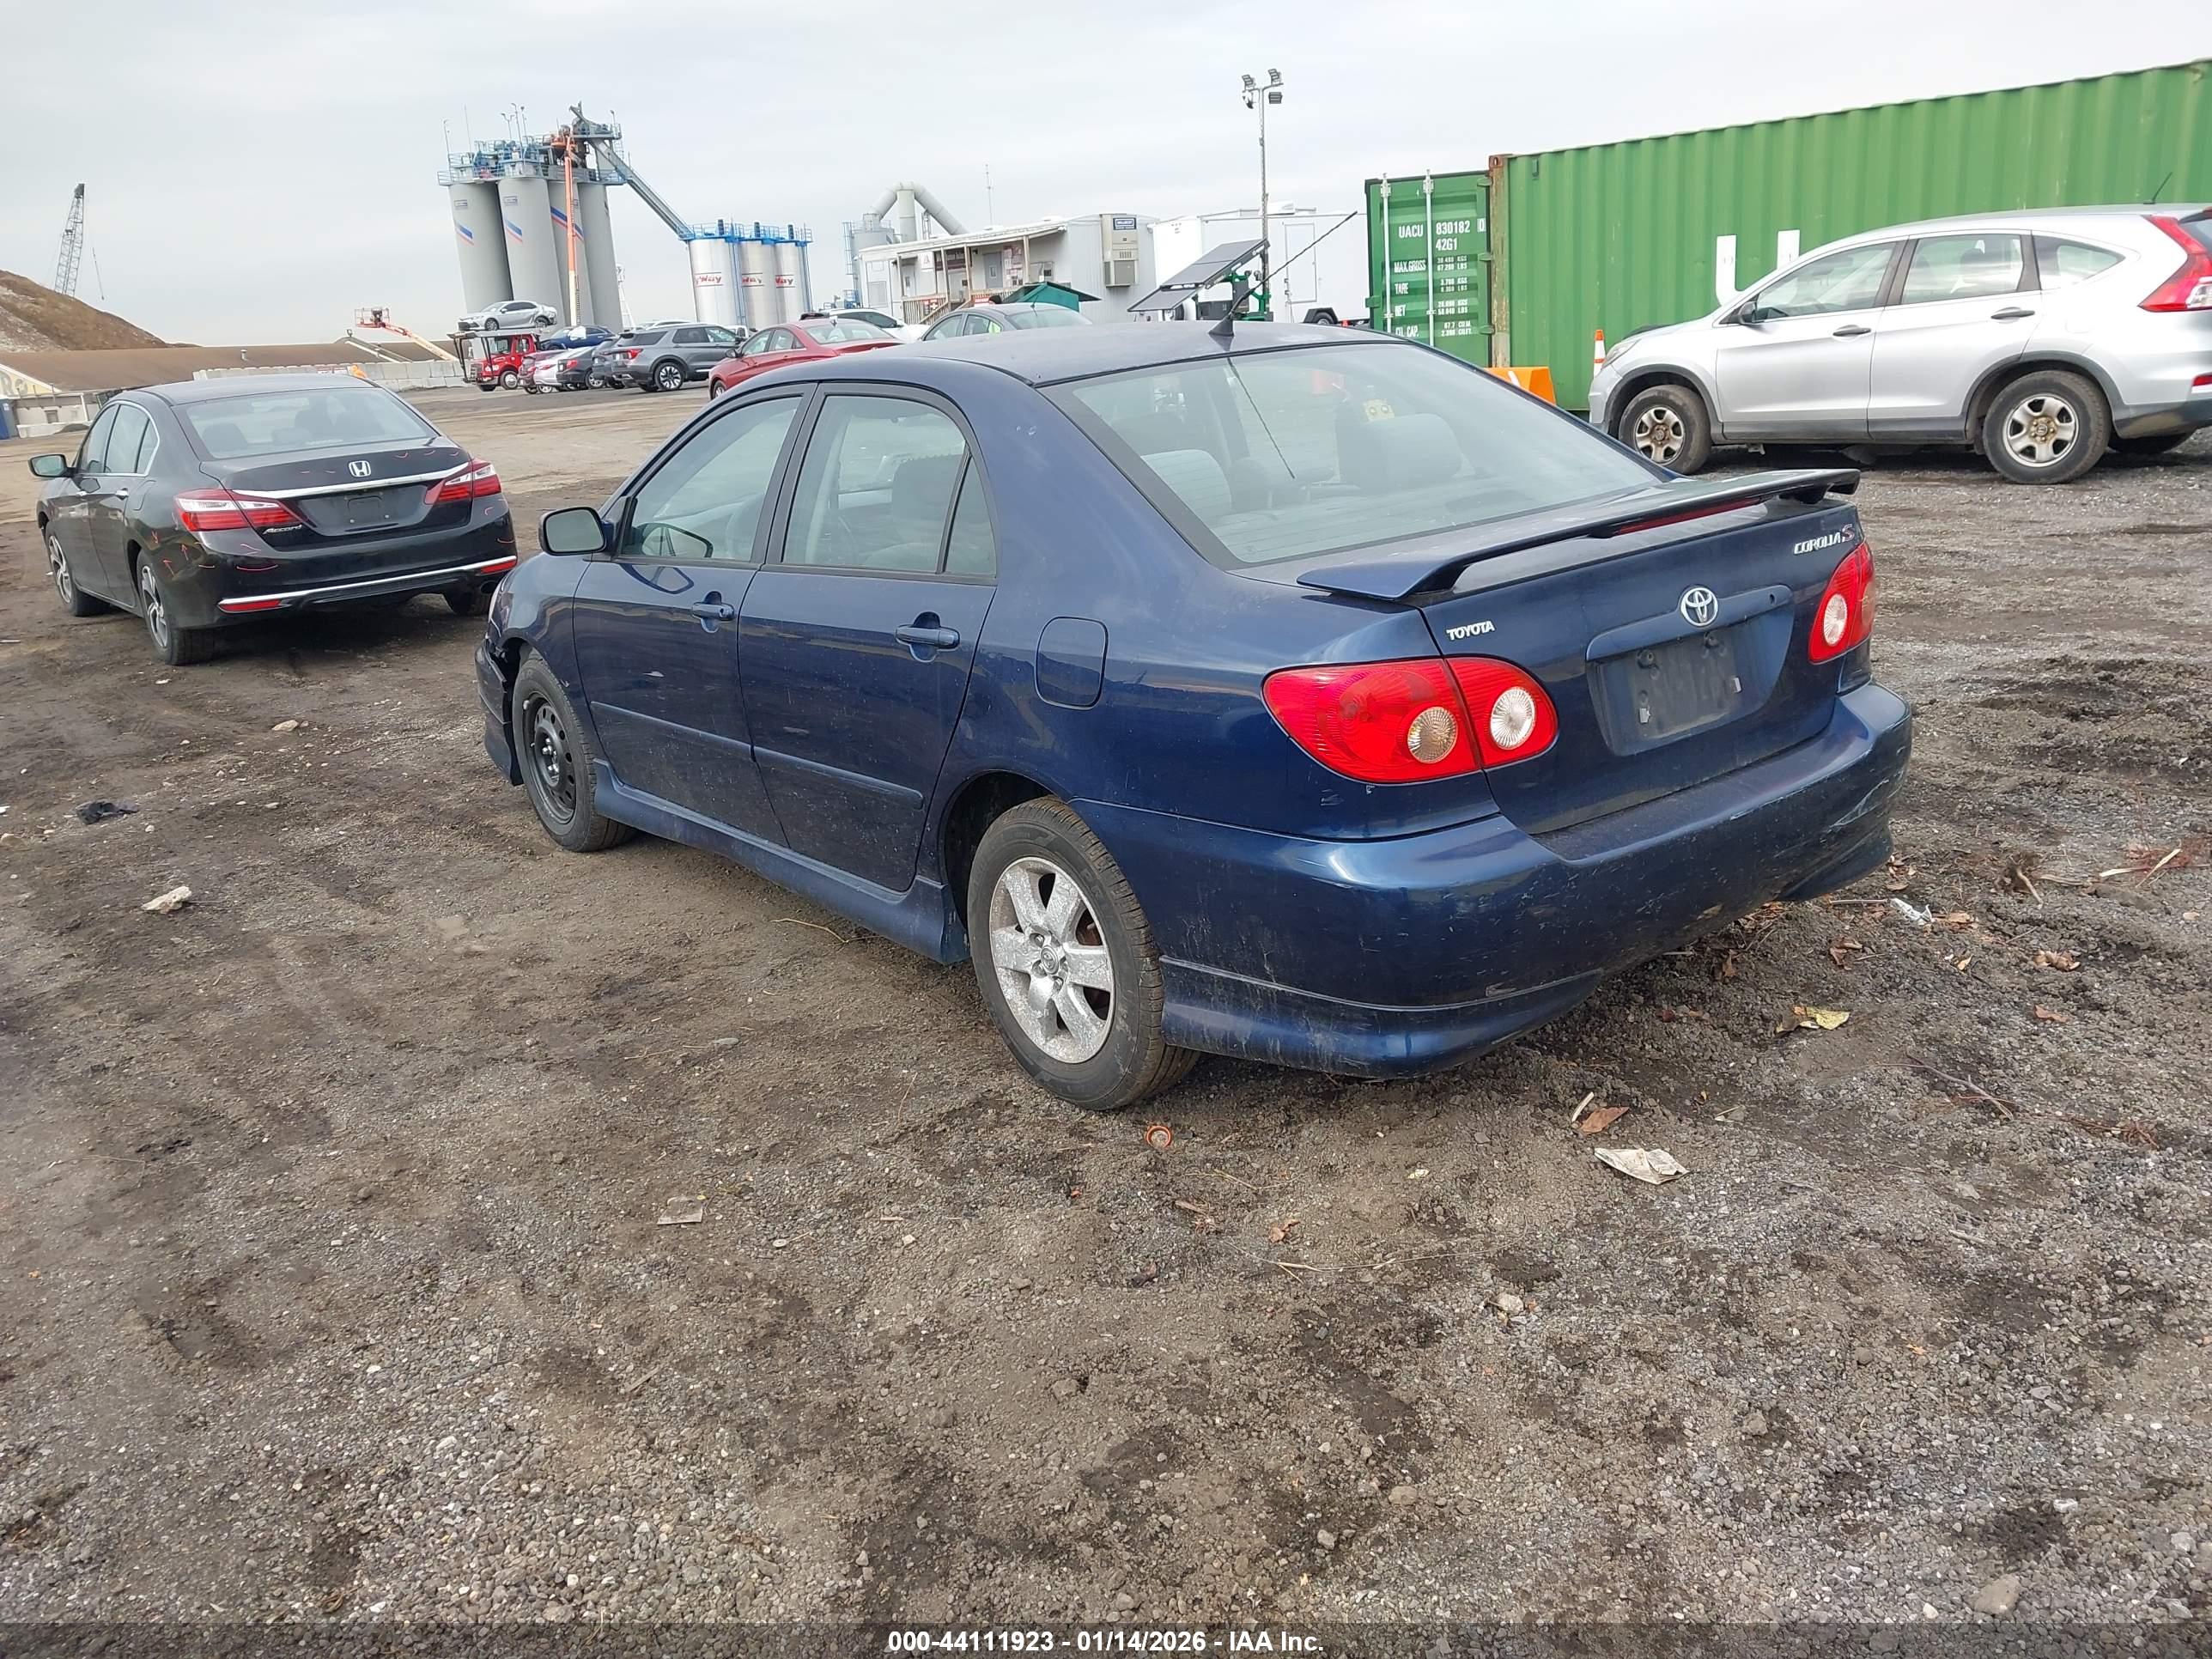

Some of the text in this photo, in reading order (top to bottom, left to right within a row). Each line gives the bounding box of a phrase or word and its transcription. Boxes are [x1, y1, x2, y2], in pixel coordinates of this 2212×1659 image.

[1398, 224, 1424, 239] UACU
[1436, 220, 1470, 235] 830182
[1435, 237, 1457, 251] 42G1
[1395, 282, 1408, 295] TARE
[1395, 304, 1406, 317] NET
[1794, 532, 1841, 555] COROLLA
[1445, 620, 1496, 641] TOYOTA
